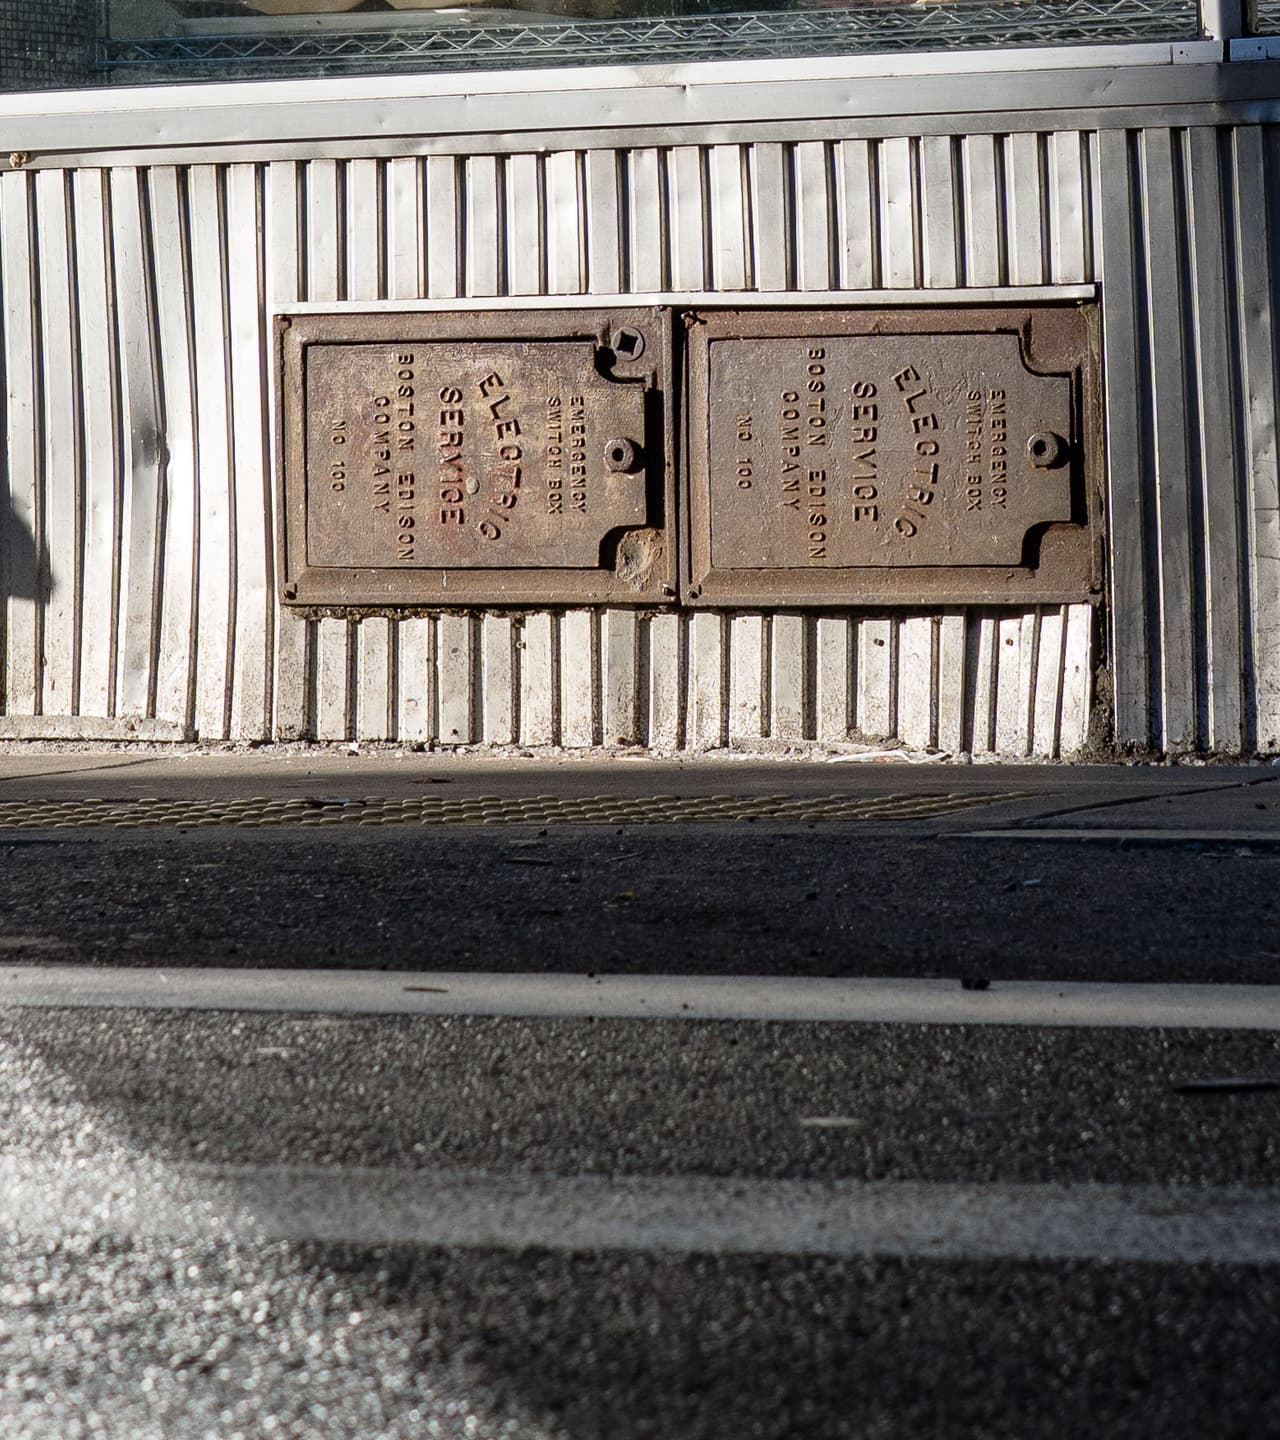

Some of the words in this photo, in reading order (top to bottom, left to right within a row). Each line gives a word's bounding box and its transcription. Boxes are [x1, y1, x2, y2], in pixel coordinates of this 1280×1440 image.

[332, 420, 346, 445] NO
[397, 352, 415, 451] BOSTON
[546, 396, 562, 470] SWITCH
[736, 416, 752, 441] NO
[807, 347, 825, 447] BOSTON
[966, 390, 982, 464] SWITCH
[331, 461, 346, 493] 100
[373, 395, 391, 514] COMPANY
[439, 385, 465, 525] SERVICE
[478, 371, 523, 541] ELECTRIC
[570, 396, 587, 514] EMERGENCY
[736, 458, 752, 490] 100
[781, 390, 800, 511] COMPANY
[852, 380, 878, 522] SERVICE
[891, 365, 940, 538] ELECTRIC
[966, 474, 982, 511] BOX
[990, 389, 1007, 510] EMERGENCY
[397, 472, 415, 561] EDISON
[547, 480, 563, 515] BOX
[807, 469, 826, 559] EDISON
